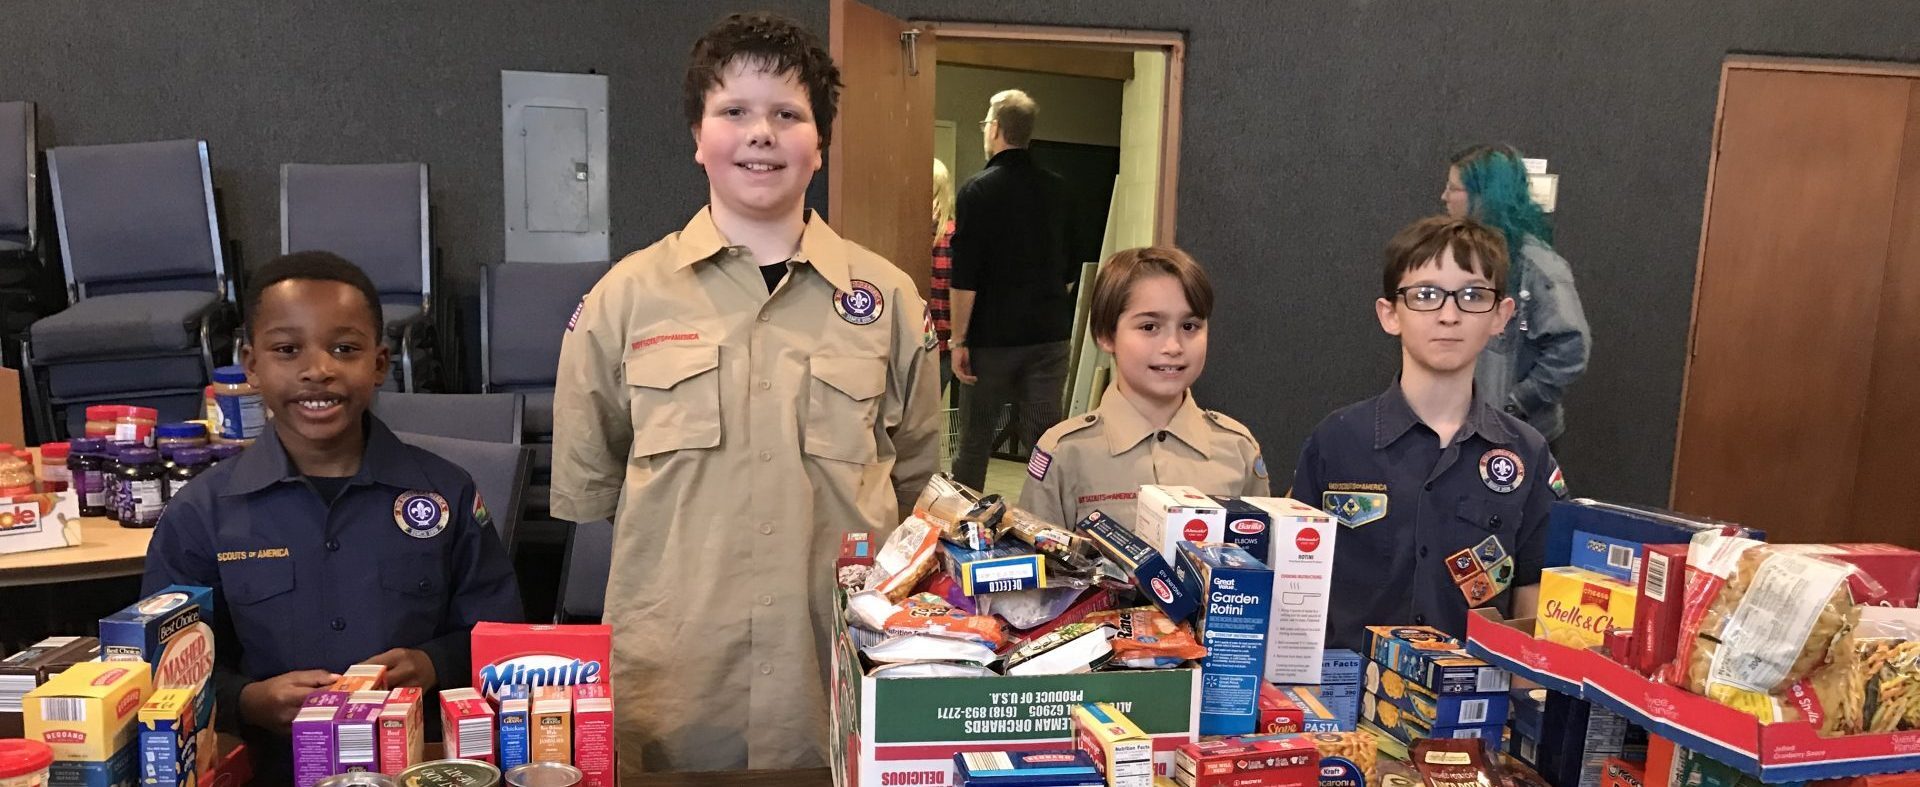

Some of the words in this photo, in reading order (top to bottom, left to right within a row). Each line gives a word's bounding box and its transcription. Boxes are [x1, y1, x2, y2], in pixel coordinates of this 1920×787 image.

[1236, 521, 1263, 531] Barilla
[217, 550, 247, 562] SCOUTS
[257, 547, 290, 560] AMERICA
[988, 579, 1012, 593] CECCO
[1011, 578, 1023, 591] DE
[1213, 577, 1236, 586] Great
[1211, 591, 1260, 605] Garden
[1210, 603, 1244, 616] Rotini
[1543, 599, 1582, 627] Shells
[1582, 616, 1593, 631] &
[160, 620, 176, 639] Best
[175, 610, 200, 631] Choice
[162, 634, 207, 685] MASHED
[1333, 660, 1359, 668] Facts
[480, 659, 601, 699] Minute
[988, 691, 1017, 705] U.S.A.
[1020, 691, 1034, 703] OF
[1035, 689, 1084, 701] PRODUCE
[937, 706, 988, 720] 893-2771
[989, 706, 1017, 720] (618)
[1028, 704, 1065, 718] 62905
[1798, 698, 1820, 724] Shlls
[964, 718, 1033, 734] ORCHARDS
[1304, 722, 1340, 732] PASTA
[881, 770, 945, 786] DELICIOUS
